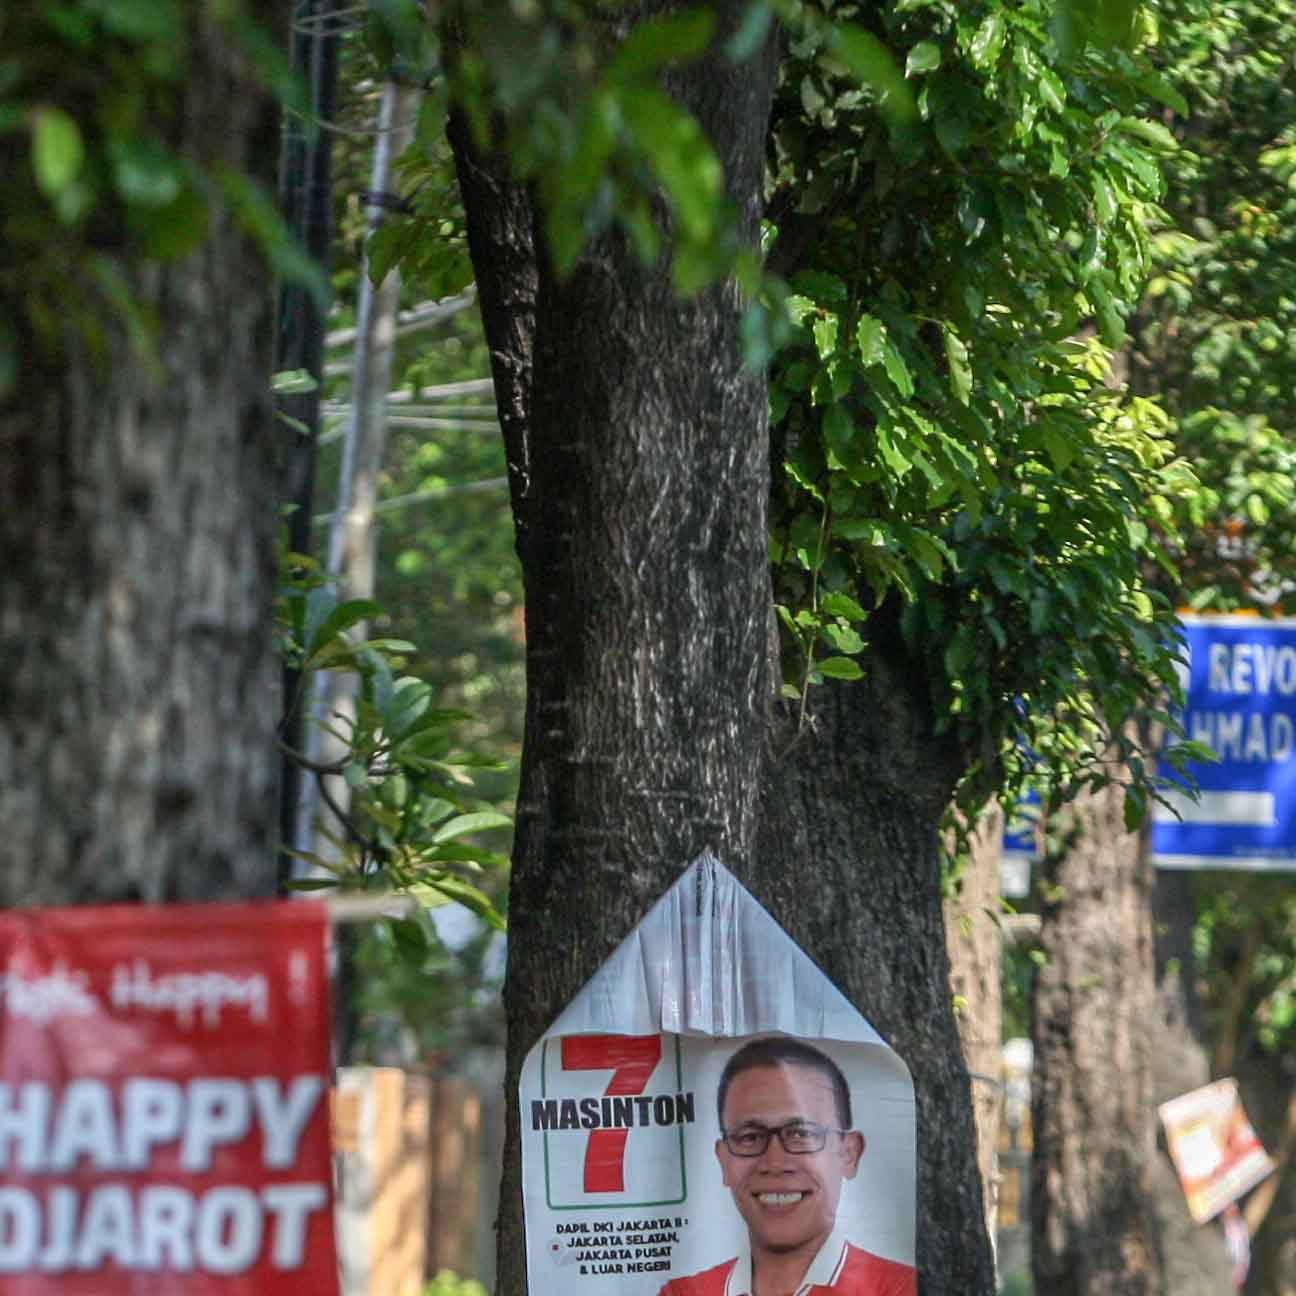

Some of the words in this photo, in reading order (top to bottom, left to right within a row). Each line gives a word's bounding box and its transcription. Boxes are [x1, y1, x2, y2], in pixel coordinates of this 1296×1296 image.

[531, 1093, 695, 1130] MASINTON
[556, 1223, 590, 1234] DAPIL
[593, 1222, 613, 1233] DKI
[616, 1219, 672, 1232] JAKARTA
[567, 1236, 623, 1248] JAKARTA
[625, 1232, 680, 1245] SELATAN,
[576, 1249, 632, 1261] JAKARTA
[635, 1246, 672, 1259] PUSAT
[591, 1263, 624, 1275] LUAR
[627, 1260, 671, 1273] NEGERI
